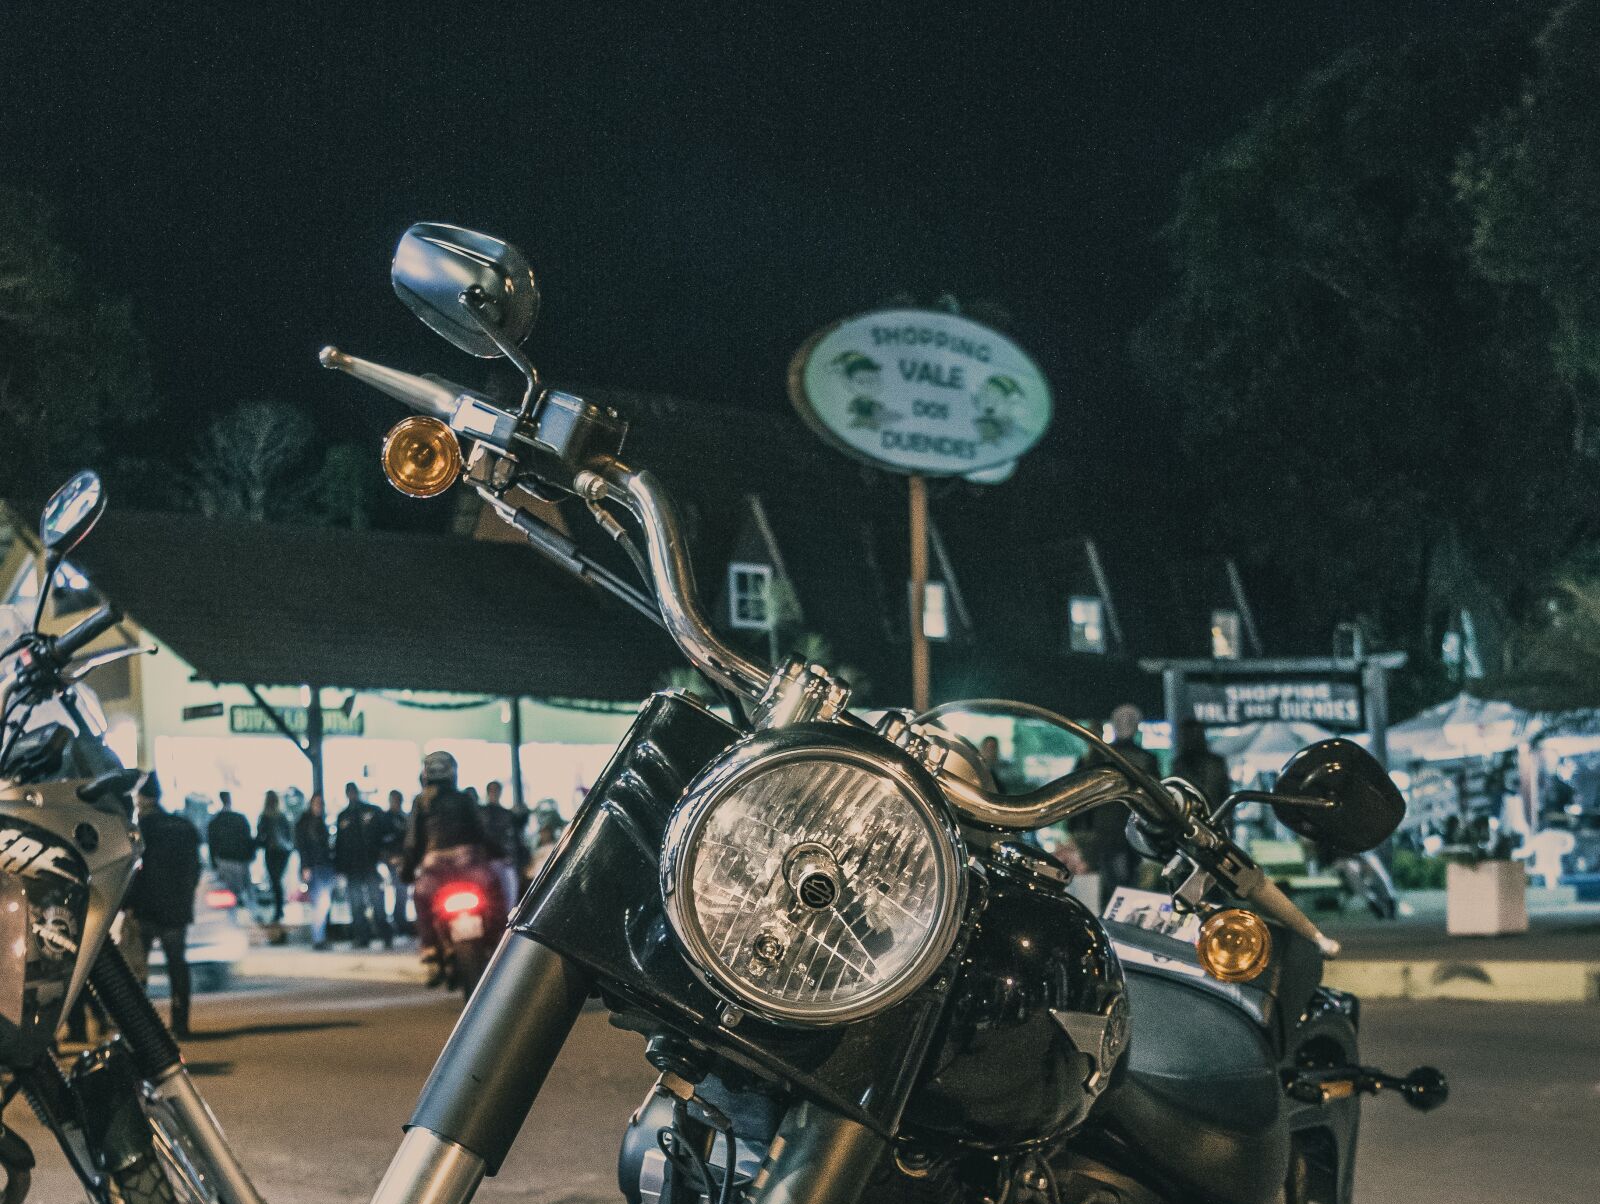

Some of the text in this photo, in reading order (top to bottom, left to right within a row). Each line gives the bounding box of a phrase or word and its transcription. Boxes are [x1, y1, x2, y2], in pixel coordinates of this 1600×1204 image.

[870, 326, 992, 363] SHOPPING
[900, 359, 964, 390] VALE
[1225, 683, 1330, 701] SHOPPING
[1193, 701, 1239, 723] VALE
